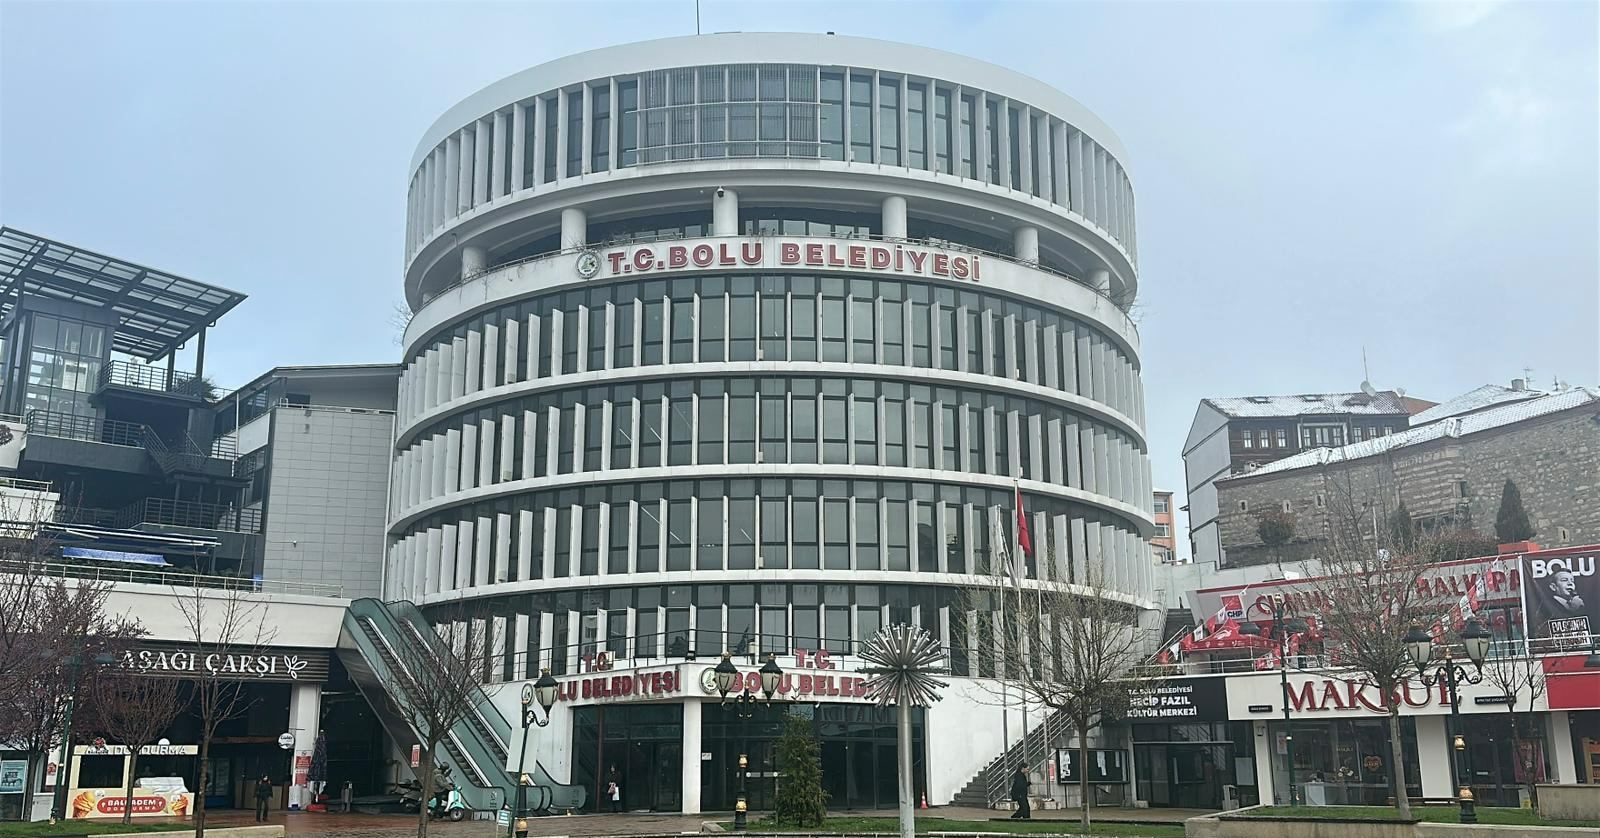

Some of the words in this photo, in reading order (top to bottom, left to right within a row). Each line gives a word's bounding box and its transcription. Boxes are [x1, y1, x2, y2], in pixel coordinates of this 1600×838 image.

[780, 242, 981, 281] BELEDİYESİ
[1531, 557, 1596, 579] BOLU
[1227, 609, 1243, 619] CHP
[119, 648, 196, 674] AŞAĞI
[205, 653, 277, 678] ÇARŞI
[795, 649, 836, 670] T.C.
[582, 664, 681, 699] BELEDİYESİ
[730, 671, 793, 694] BOU
[1157, 685, 1193, 694] BELEDİYESİ
[1129, 694, 1159, 706] NECİP
[1161, 696, 1191, 706] FAZIL
[1126, 707, 1158, 717] KÜLTÜR
[1159, 705, 1197, 717] MERKEZİ
[114, 744, 186, 755] DODURMA
